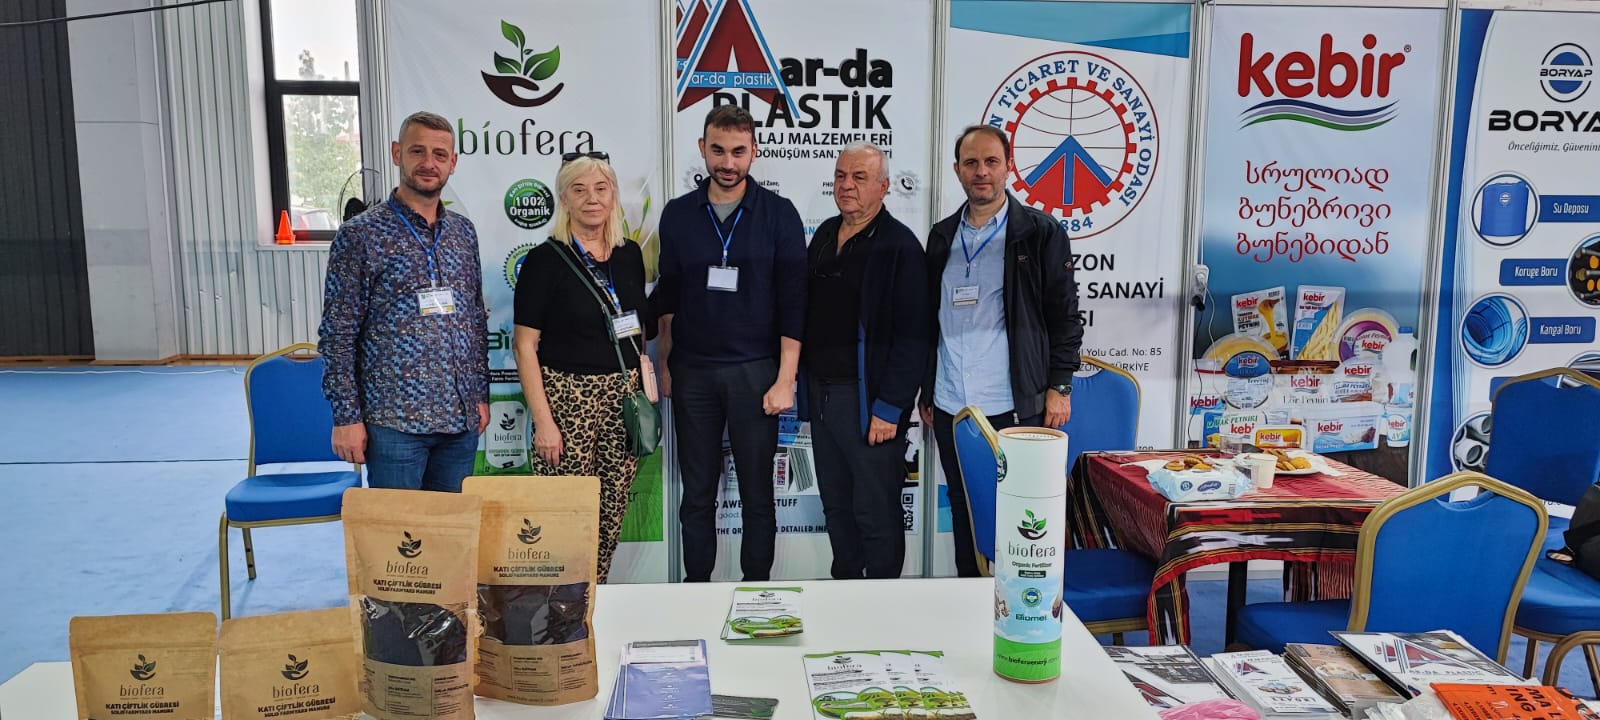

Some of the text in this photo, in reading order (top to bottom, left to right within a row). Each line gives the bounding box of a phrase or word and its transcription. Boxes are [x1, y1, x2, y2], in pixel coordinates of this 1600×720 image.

[779, 48, 893, 89] ar-da
[1238, 33, 1405, 98] kebir
[1540, 68, 1593, 78] BORYAP
[692, 73, 773, 87] ar-da plastik
[1488, 109, 1600, 133] BORYA
[457, 118, 594, 156] biofera
[752, 132, 784, 145] LAJ
[998, 60, 1155, 207] TİCARET VE SANAYİ ODASI
[1246, 160, 1389, 192] სრულიად
[515, 196, 545, 207] 100%
[509, 206, 551, 217] Organik
[1238, 196, 1391, 228] ბუნებრივი
[1553, 203, 1589, 214] Su Deposu
[1061, 216, 1093, 232] 884
[1236, 231, 1389, 263] ბუნებიდან
[1071, 254, 1115, 271] ZON
[1515, 266, 1558, 278] Koruge Boru
[1087, 278, 1164, 299] SANAYİ
[1303, 292, 1326, 301] kebir
[1236, 297, 1259, 309] kebir
[1540, 325, 1581, 337] Kangal Boru
[1361, 340, 1386, 351] kebir
[1086, 348, 1106, 356] Yolu
[1109, 348, 1128, 356] Cad.
[1149, 348, 1162, 356] 85
[1238, 356, 1258, 365] kebir
[1344, 365, 1372, 375] kebir
[1290, 375, 1321, 388] kebir
[1190, 396, 1219, 407] kebir
[1317, 421, 1344, 432] kebir
[494, 433, 522, 442] biofera
[1260, 432, 1282, 440] kebir
[774, 499, 797, 507] TUFF
[508, 548, 550, 560] biofera
[1008, 541, 1056, 558] biofera
[386, 560, 428, 576] biofera
[120, 683, 165, 697] biofera
[272, 682, 320, 699] biofera
[149, 700, 180, 708] GÜBRESİ
[305, 696, 336, 708] GÜBRESİ
